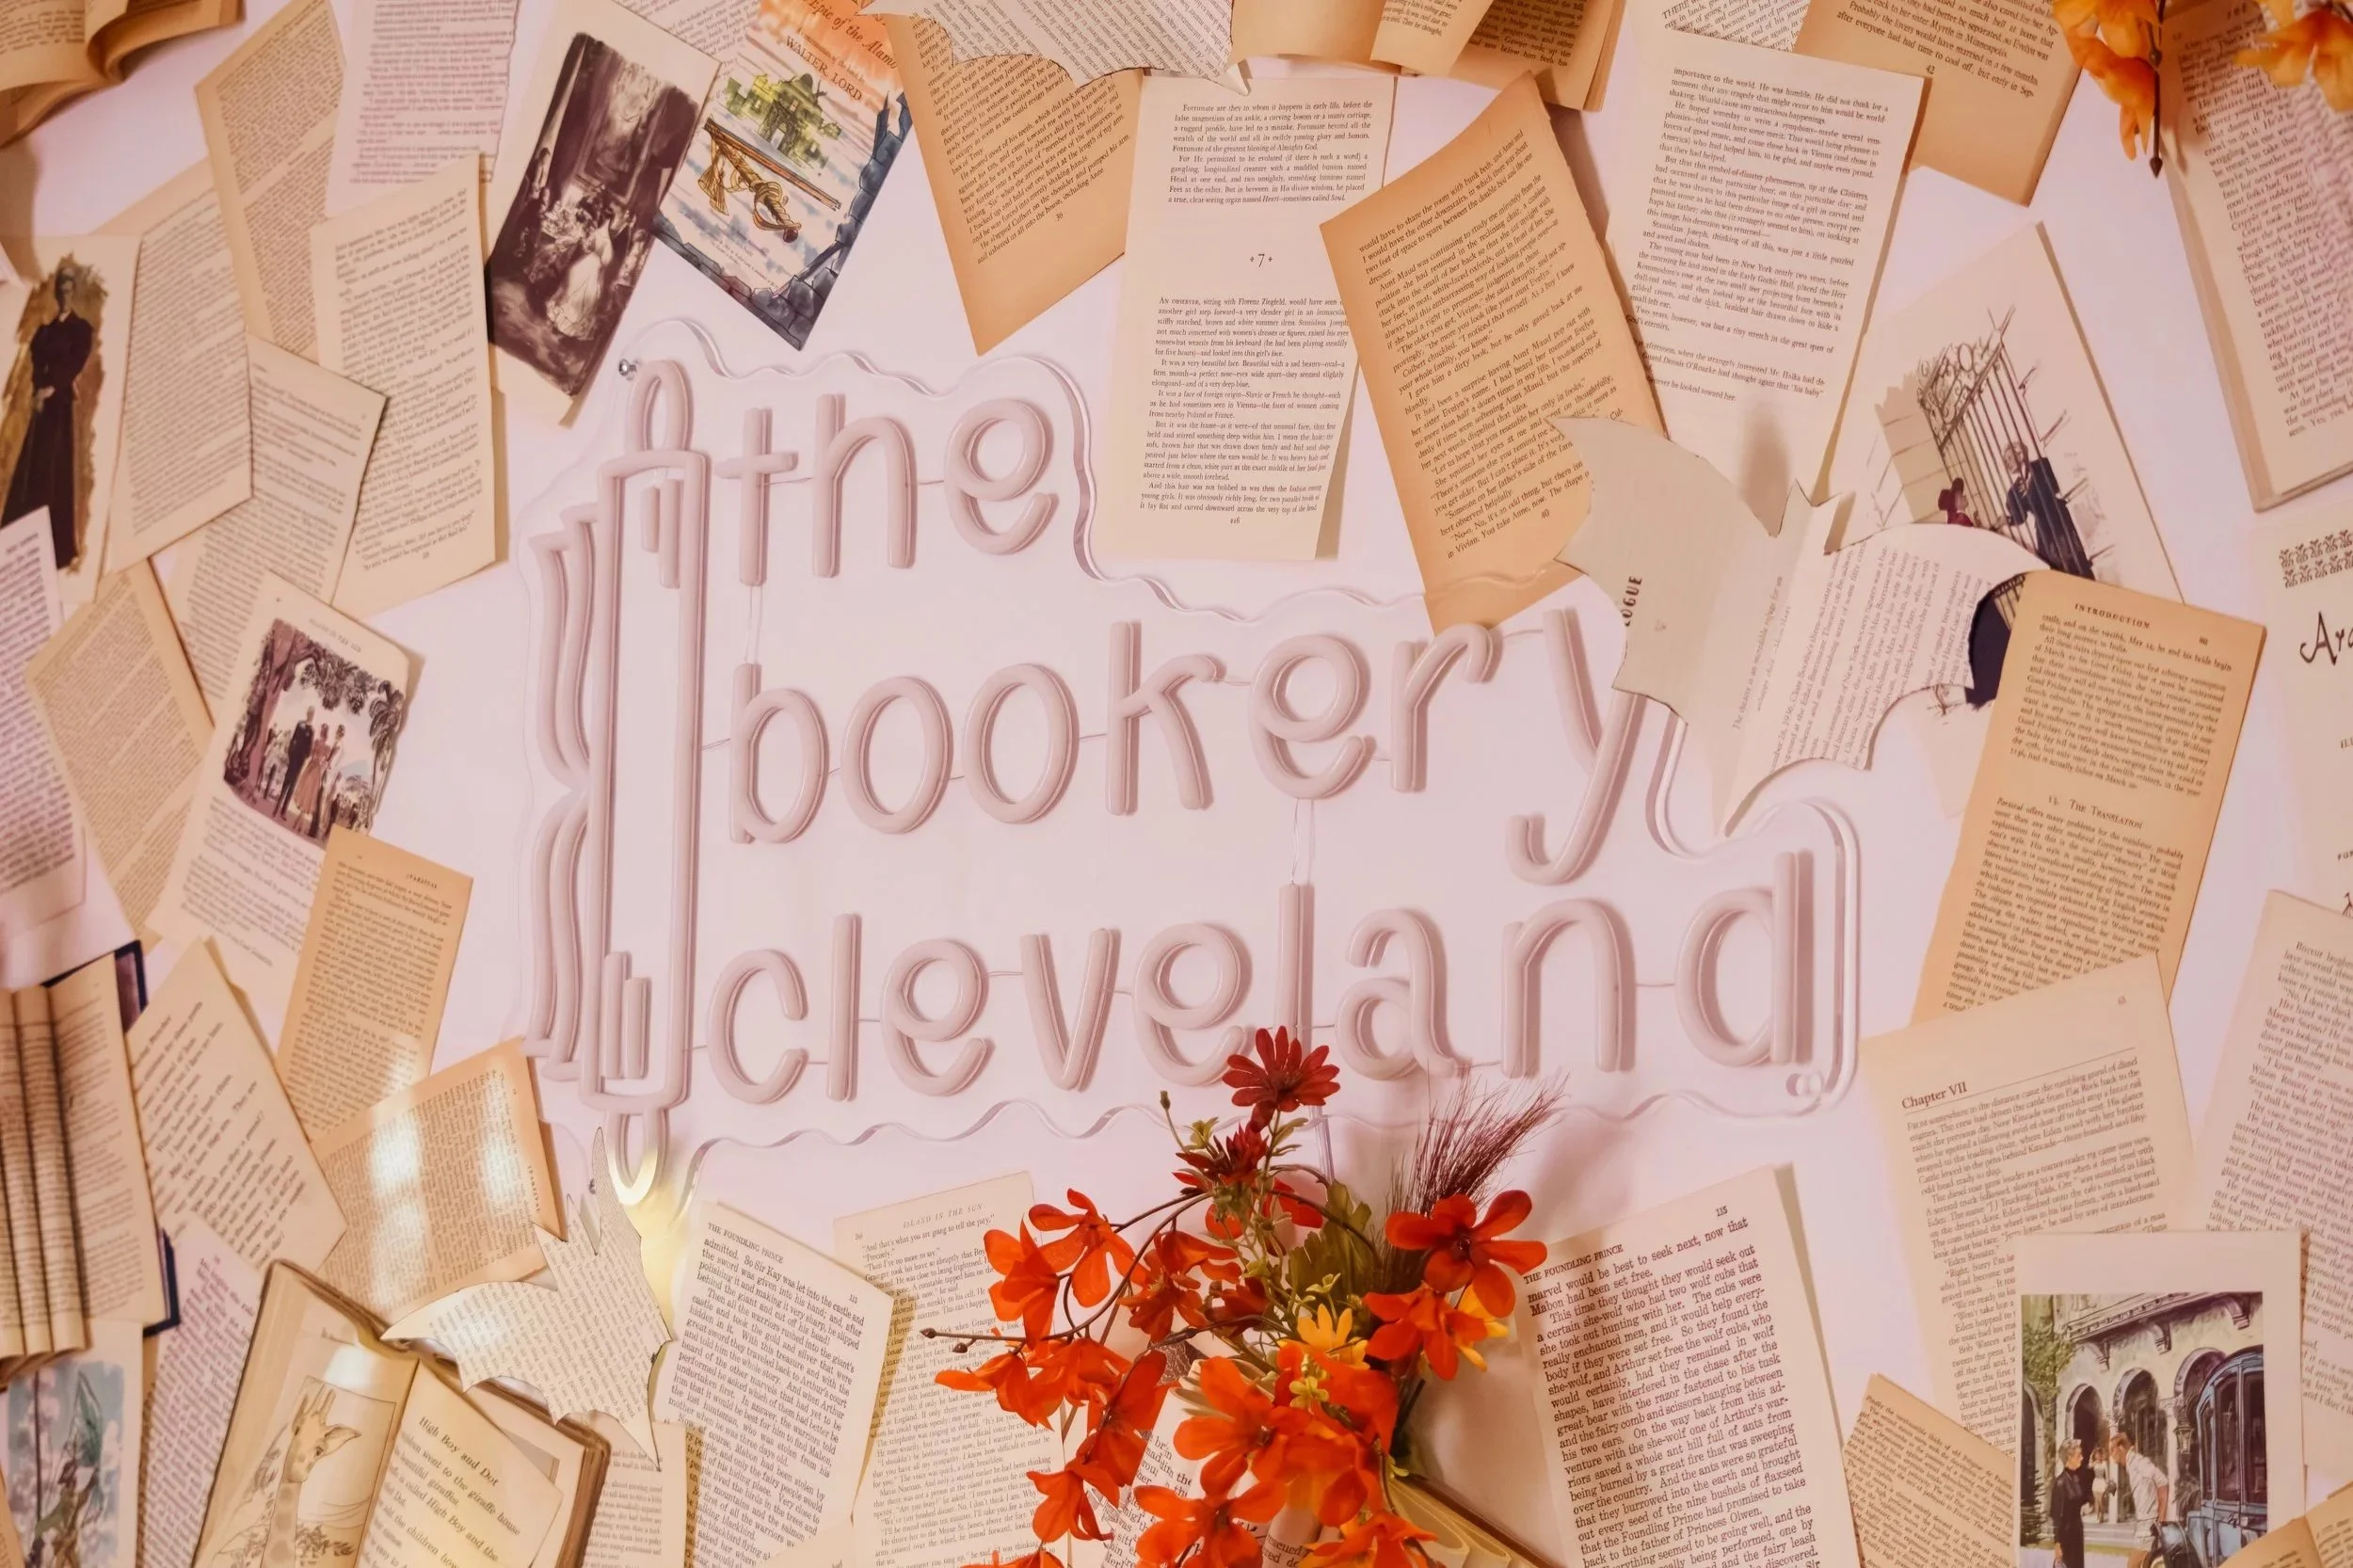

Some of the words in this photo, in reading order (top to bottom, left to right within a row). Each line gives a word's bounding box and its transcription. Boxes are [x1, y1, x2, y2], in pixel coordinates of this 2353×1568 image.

[785, 36, 828, 77] WALTER
[832, 72, 862, 101] LORD
[808, 0, 834, 19] Epic
[832, 17, 851, 30] of
[846, 25, 863, 41] the
[862, 40, 897, 69] Alamo
[1257, 253, 1265, 268] 7
[1380, 277, 1396, 292] Aunt
[1396, 264, 1416, 281] Maud
[1416, 258, 1429, 268] was
[1429, 235, 1464, 261] continuing
[1463, 231, 1470, 239] to
[1470, 217, 1487, 234] study
[1488, 212, 1497, 222] me
[714, 394, 1056, 587] the
[2074, 603, 2151, 629] INTRODUCTION
[729, 608, 1640, 885] bookery
[708, 852, 1814, 1103] cleveland
[1901, 1090, 1946, 1109] Chapter
[1947, 1080, 1967, 1096] VII
[703, 1238, 738, 1260] admitted.
[743, 1255, 753, 1267] So
[753, 1260, 766, 1272] Sir
[762, 1266, 782, 1282] Kay
[781, 1276, 795, 1288] was
[795, 1281, 806, 1294] let
[806, 1287, 822, 1303] into
[820, 1294, 832, 1308] the
[832, 1303, 852, 1319] castle
[851, 1313, 864, 1326] and
[1522, 1271, 1542, 1285] THE
[1543, 1255, 1592, 1277] FOUNDLING
[1593, 1244, 1624, 1261] PRINCE
[1527, 1281, 1562, 1304] marvel
[1564, 1270, 1595, 1290] would
[1595, 1268, 1609, 1280] be
[1611, 1257, 1634, 1274] best
[1637, 1255, 1647, 1265] to
[1650, 1244, 1673, 1261] seek
[1675, 1234, 1701, 1252] next,
[1704, 1227, 1723, 1241] now
[1726, 1216, 1748, 1233] that
[1548, 1308, 1572, 1324] This
[1573, 1302, 1596, 1316] time
[1596, 1294, 1620, 1308] they
[1621, 1278, 1659, 1301] thought
[1660, 1272, 1681, 1286] they
[1684, 1257, 1714, 1277] would
[1715, 1250, 1737, 1267] seek
[1738, 1243, 1755, 1258] out
[707, 1288, 726, 1304] Then
[726, 1299, 737, 1310] all
[737, 1303, 749, 1318] the
[750, 1311, 782, 1334] warriors
[779, 1327, 805, 1346] rushed
[804, 1337, 819, 1352] into
[820, 1346, 831, 1360] the
[1536, 1333, 1544, 1342] a
[1546, 1320, 1580, 1339] certain
[1582, 1303, 1623, 1327] she-wolf
[1625, 1299, 1645, 1313] who
[1645, 1288, 1667, 1305] had
[1668, 1285, 1687, 1298] two
[1689, 1273, 1711, 1289] wolf
[1714, 1267, 1736, 1282] cubs
[1737, 1256, 1759, 1272] that
[419, 1416, 439, 1437] High
[440, 1433, 459, 1452] Boy
[460, 1452, 480, 1469] and
[479, 1467, 498, 1486] Dot
